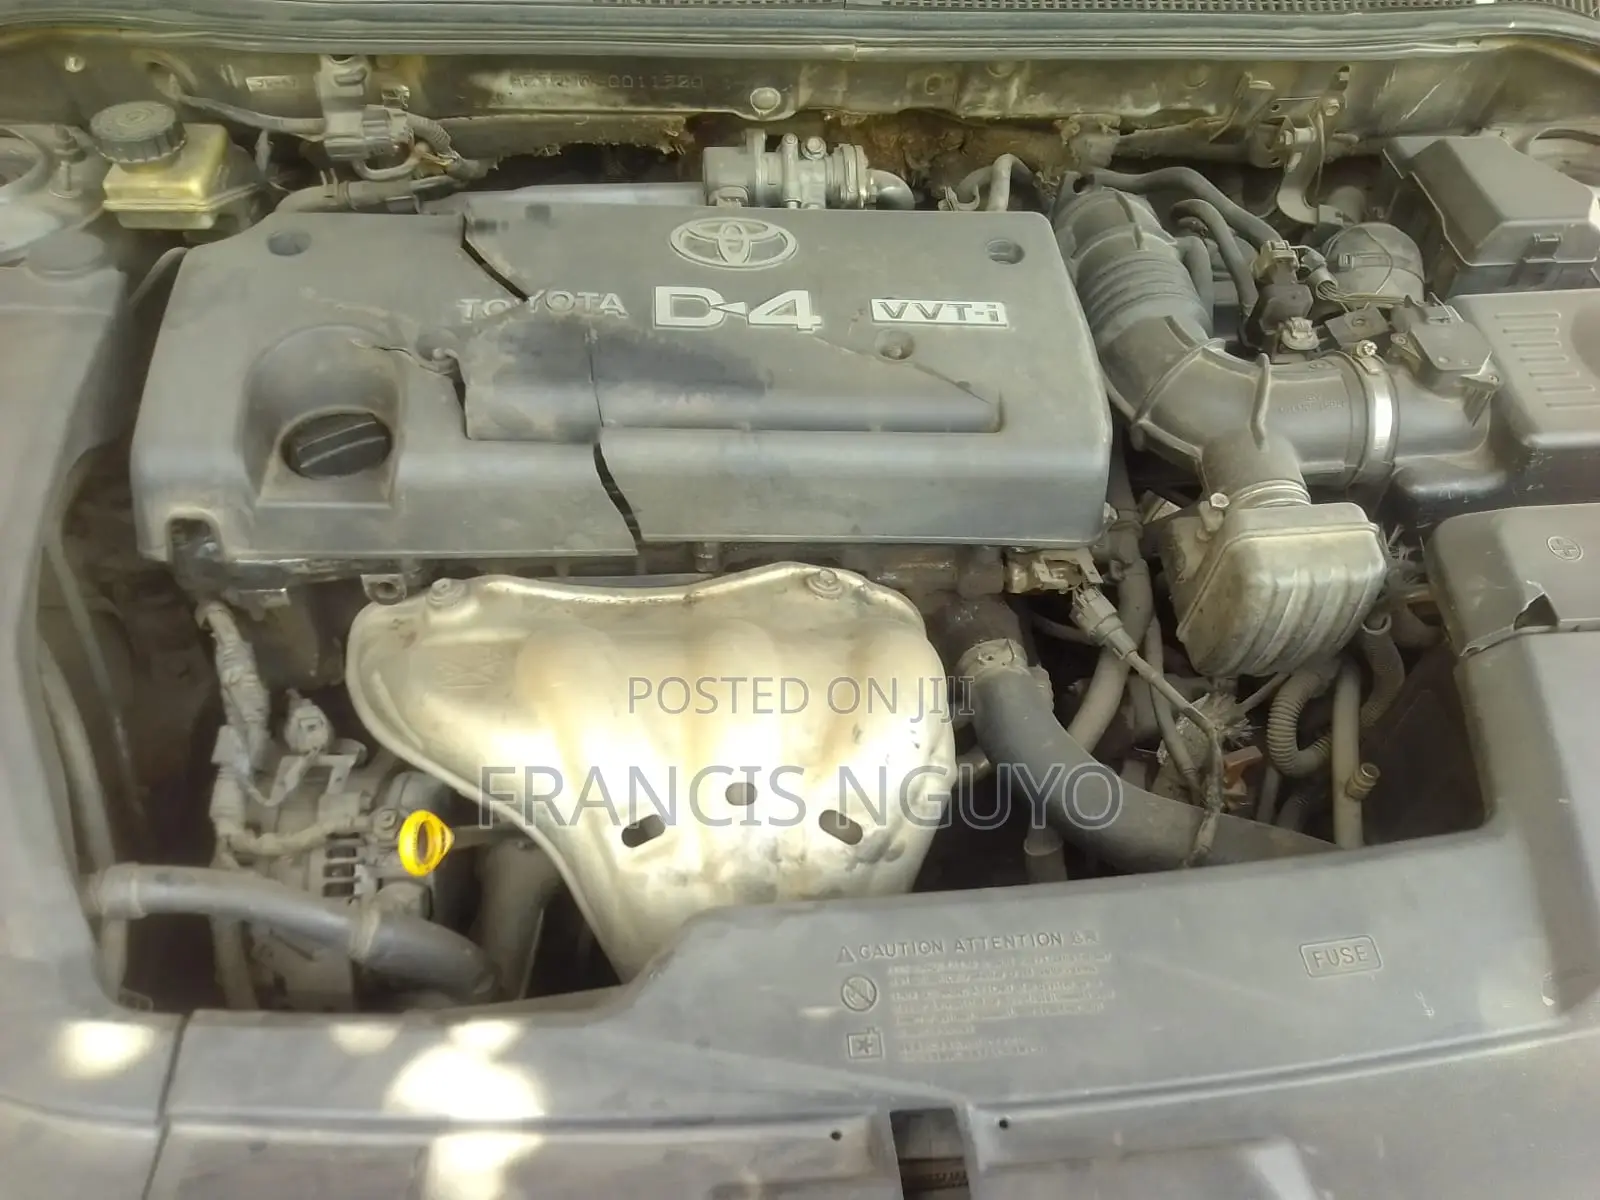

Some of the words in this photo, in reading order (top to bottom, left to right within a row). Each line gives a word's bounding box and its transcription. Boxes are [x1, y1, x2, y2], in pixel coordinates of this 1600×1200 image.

[460, 289, 629, 321] TOYOTA
[652, 285, 823, 332] D-4
[874, 301, 1003, 324] VVT-i
[859, 939, 945, 961] CAUTION
[954, 931, 1064, 954] ATTENTION
[1311, 944, 1370, 969] FUSE
